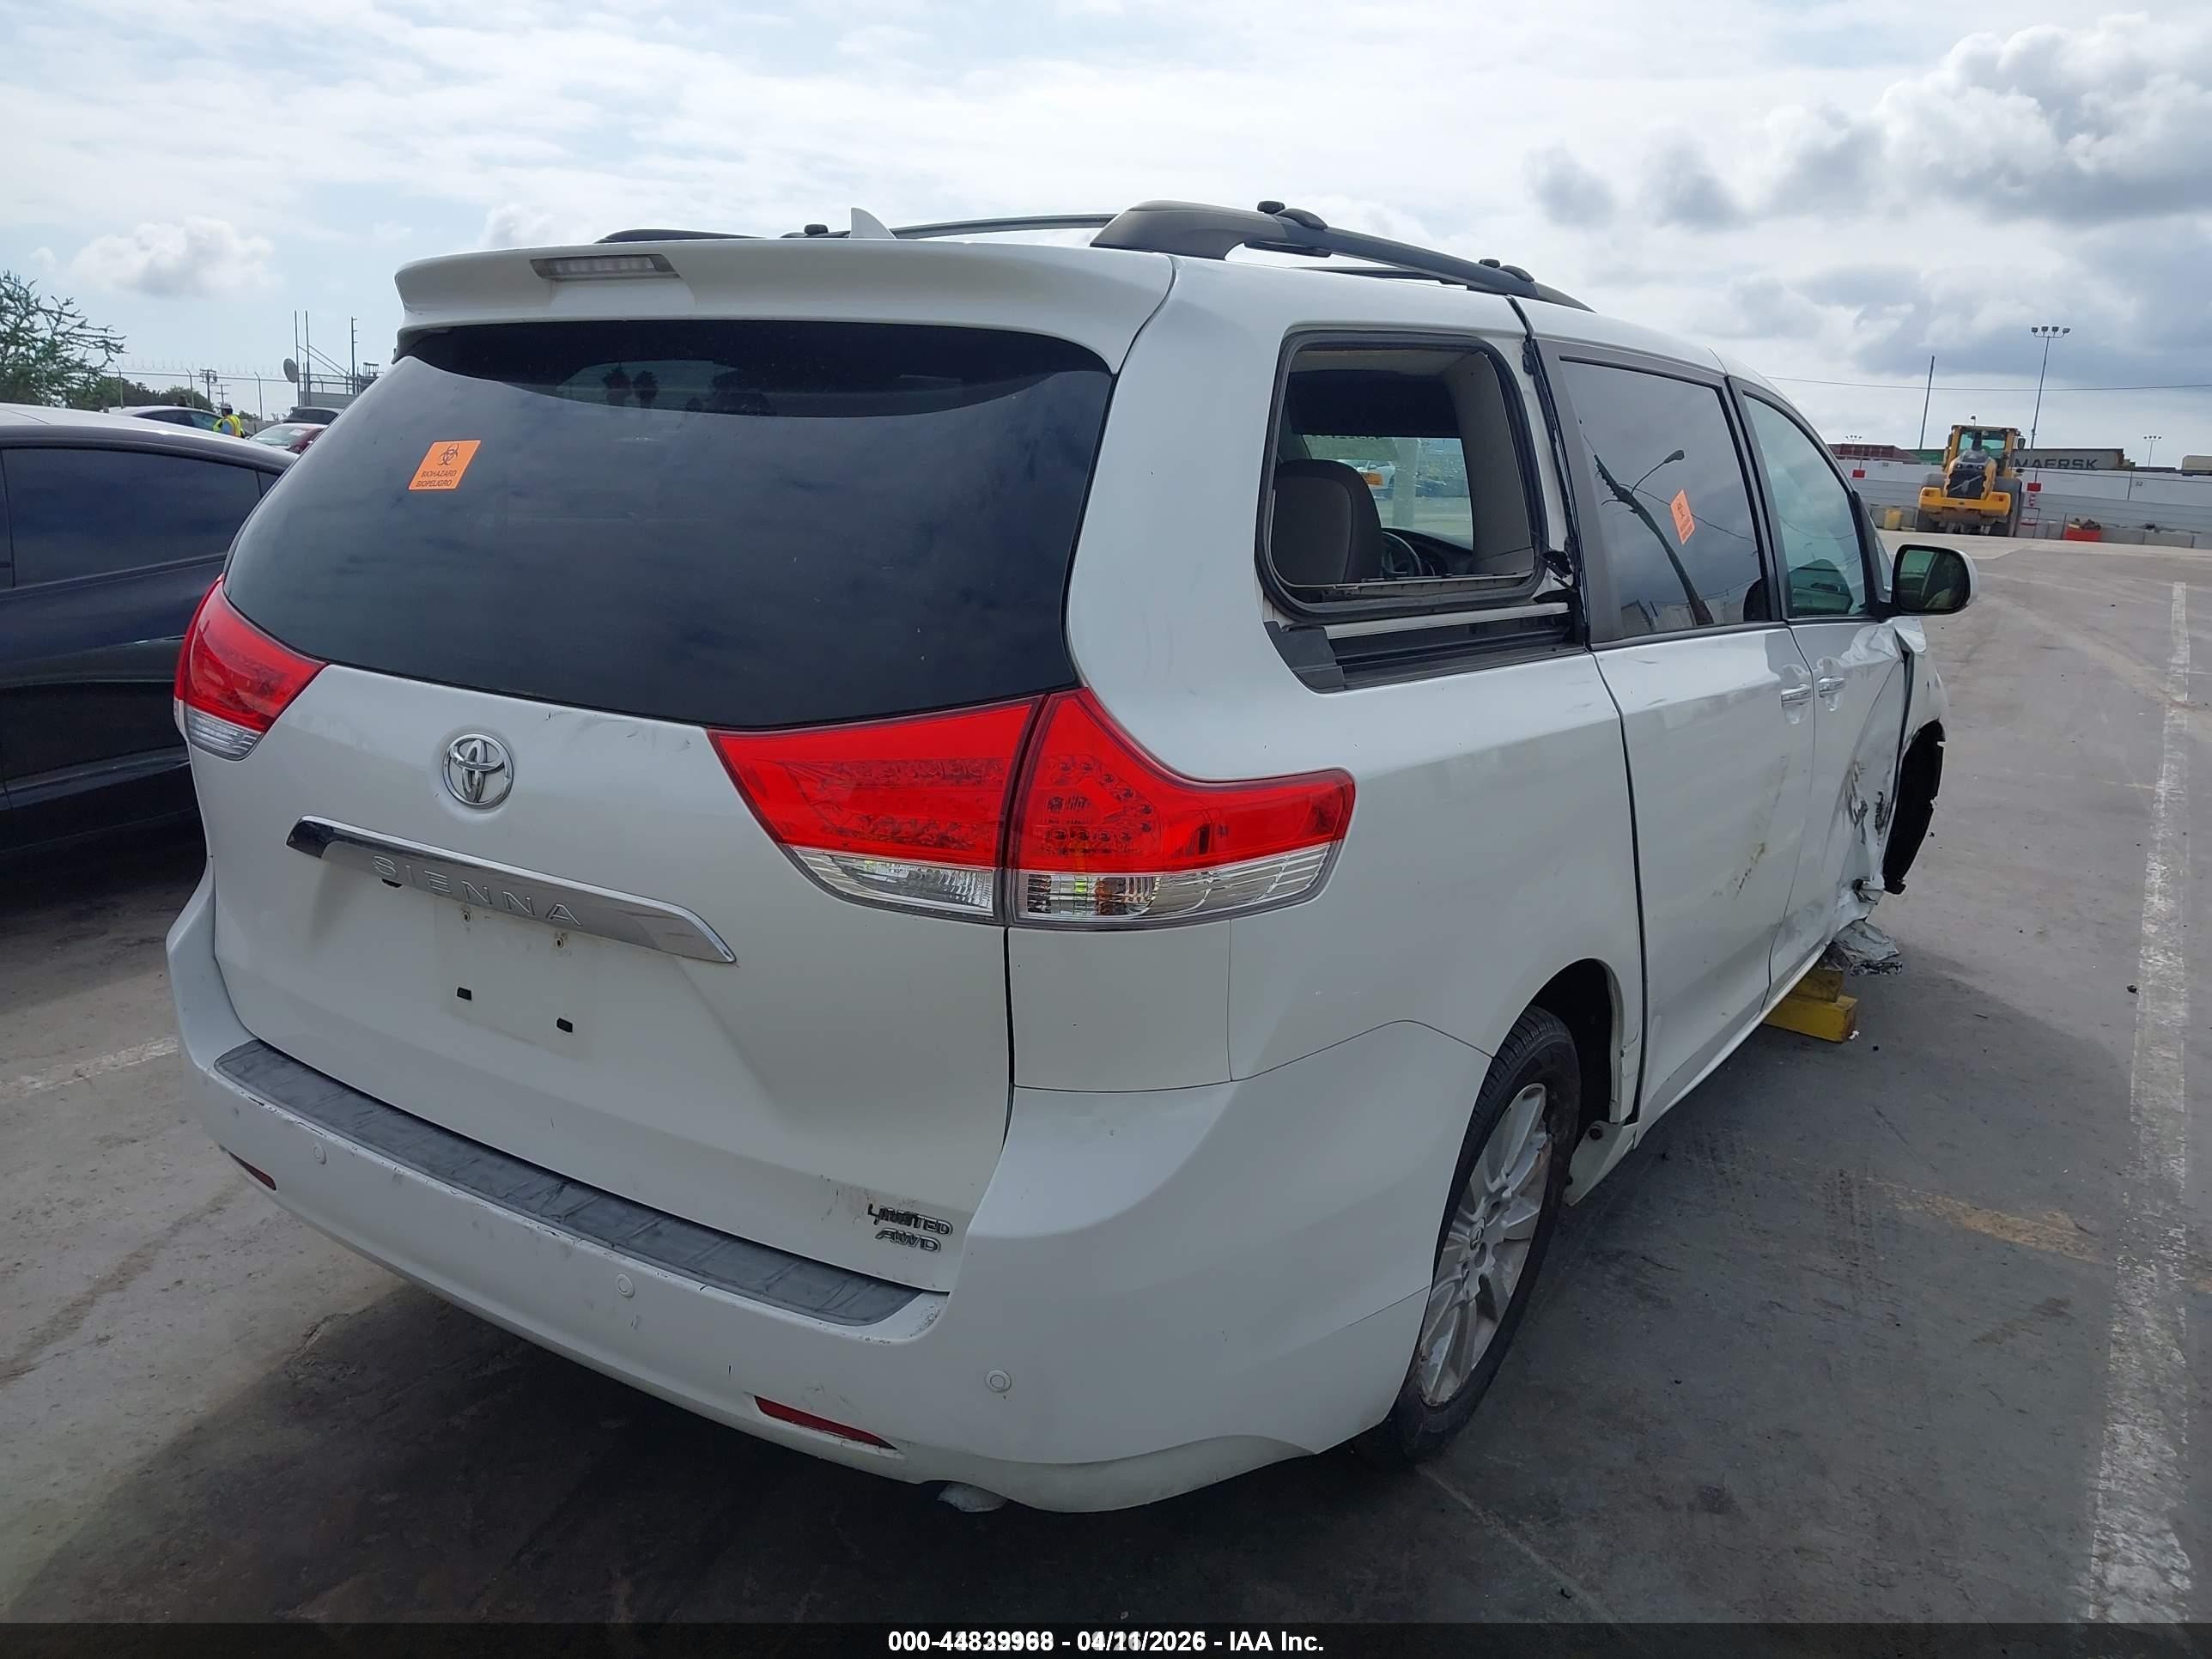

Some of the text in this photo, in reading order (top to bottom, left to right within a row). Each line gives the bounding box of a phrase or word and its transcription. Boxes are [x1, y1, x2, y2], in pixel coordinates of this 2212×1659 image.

[2014, 459, 2099, 469] MAERSK
[416, 479, 453, 488] BIOPELIGRO
[371, 854, 584, 927] SIENNA
[875, 1228, 941, 1252] AWD
